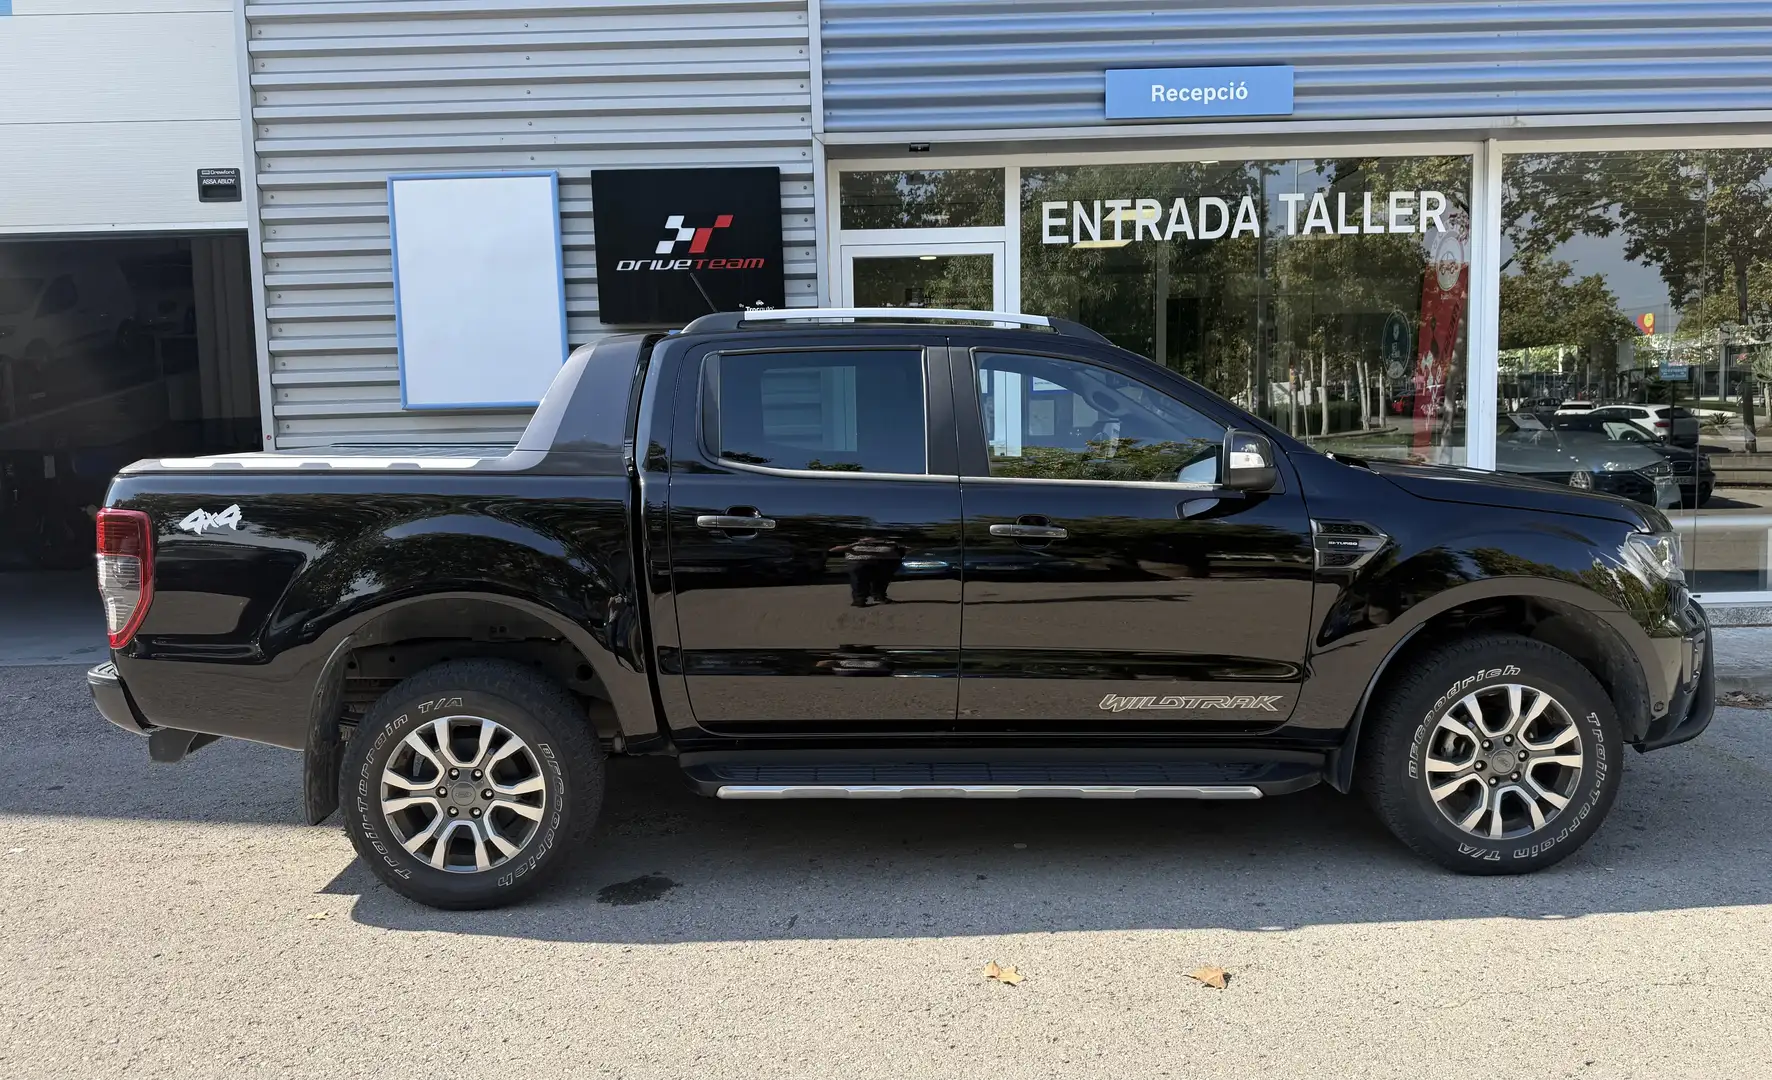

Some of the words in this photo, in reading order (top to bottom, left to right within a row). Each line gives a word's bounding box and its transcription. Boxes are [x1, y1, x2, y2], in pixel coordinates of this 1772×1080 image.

[1151, 82, 1248, 104] Recepció
[1041, 195, 1260, 245] ENTRADA
[1278, 190, 1447, 237] TALLER
[418, 697, 463, 714] T/A
[1099, 694, 1284, 712] WILDTRAK
[1408, 664, 1521, 779] BFGoodrich
[1458, 842, 1501, 861] T/A
